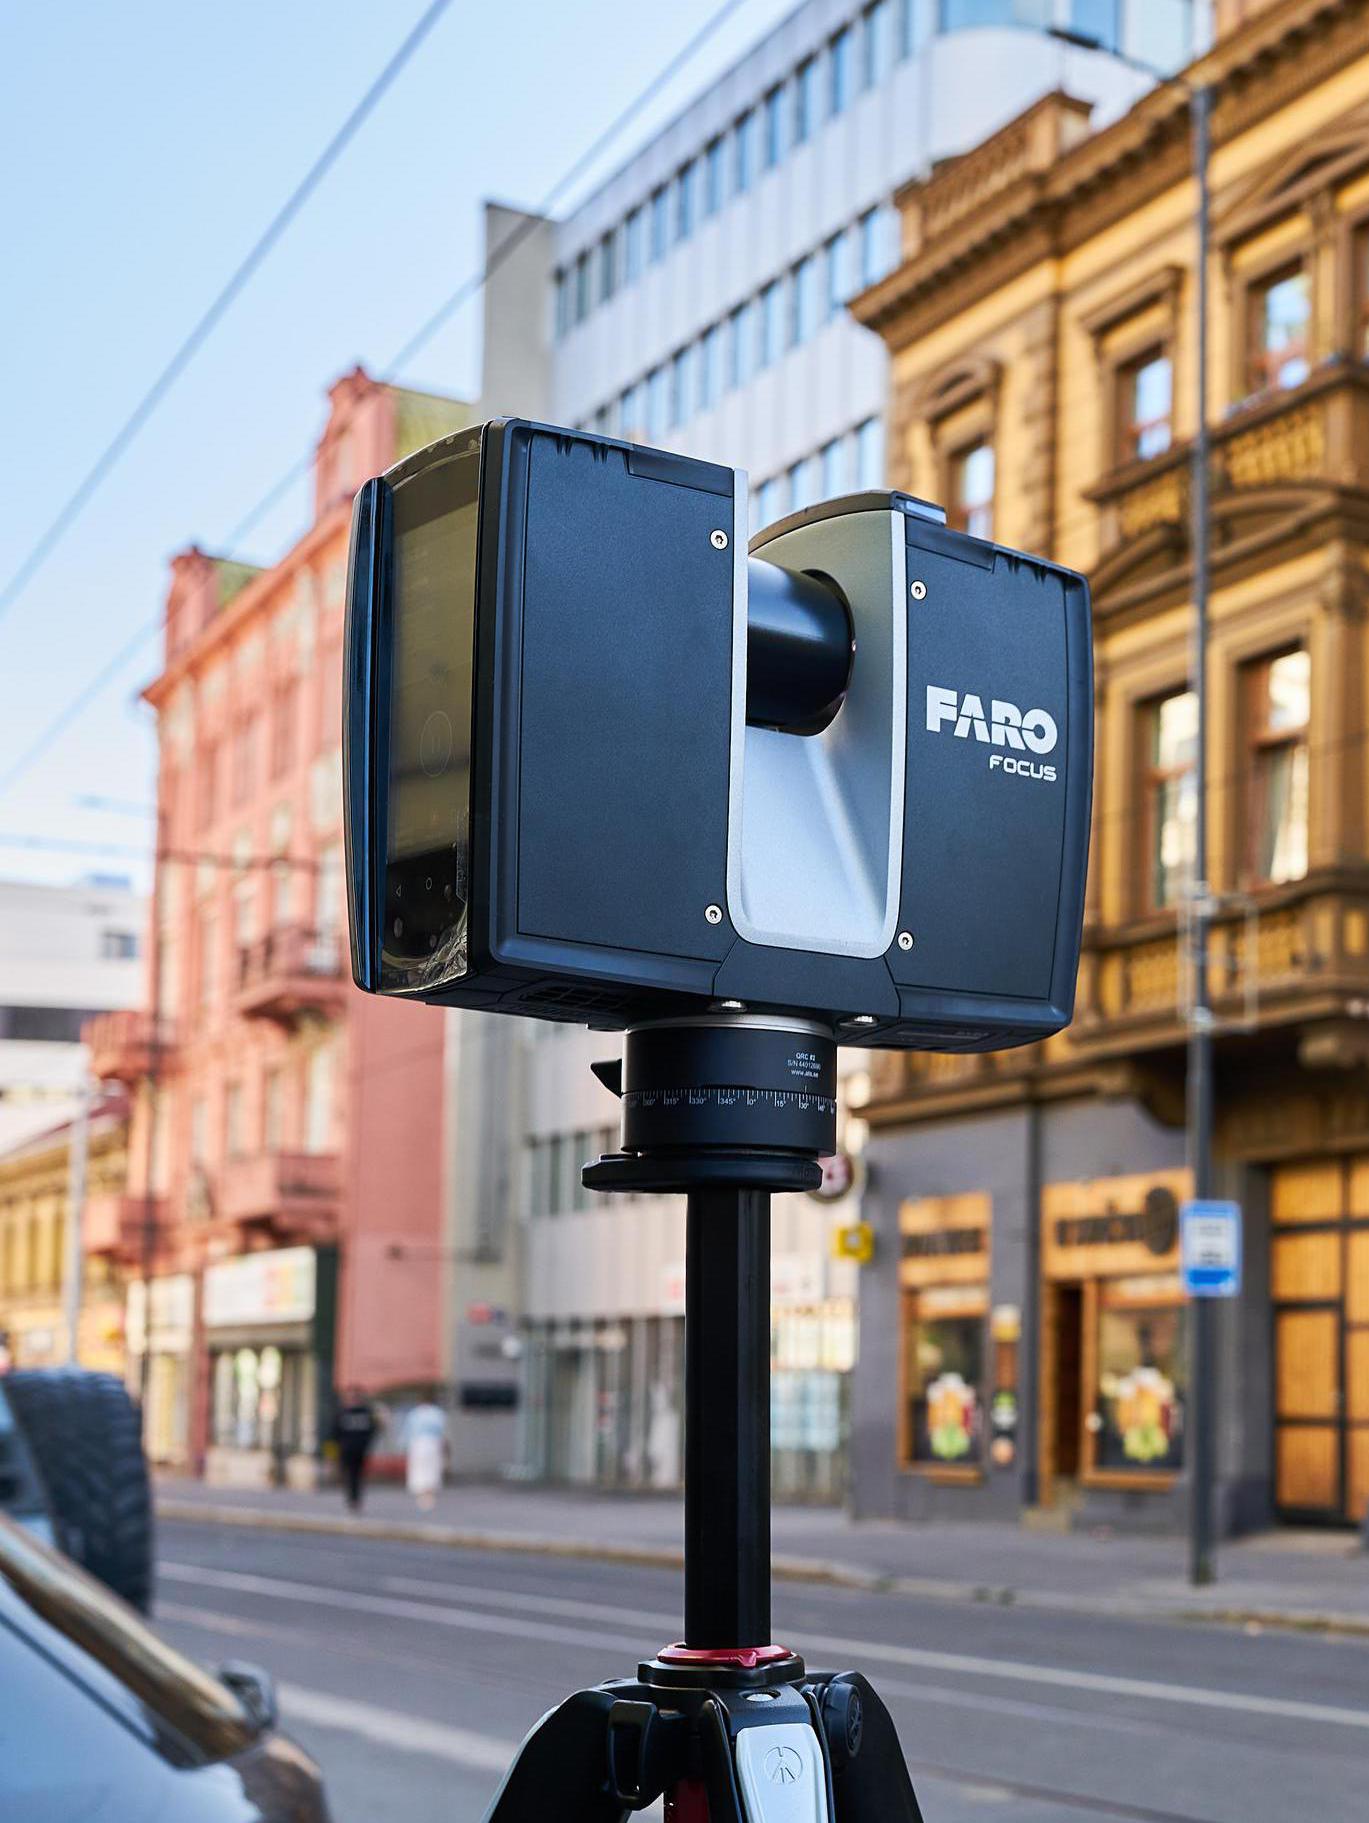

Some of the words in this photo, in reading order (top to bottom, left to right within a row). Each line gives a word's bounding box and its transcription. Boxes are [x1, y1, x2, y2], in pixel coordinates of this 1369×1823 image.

[927, 685, 1058, 754] FARO
[989, 754, 1057, 782] FOCUS
[777, 1100, 786, 1108] 15°
